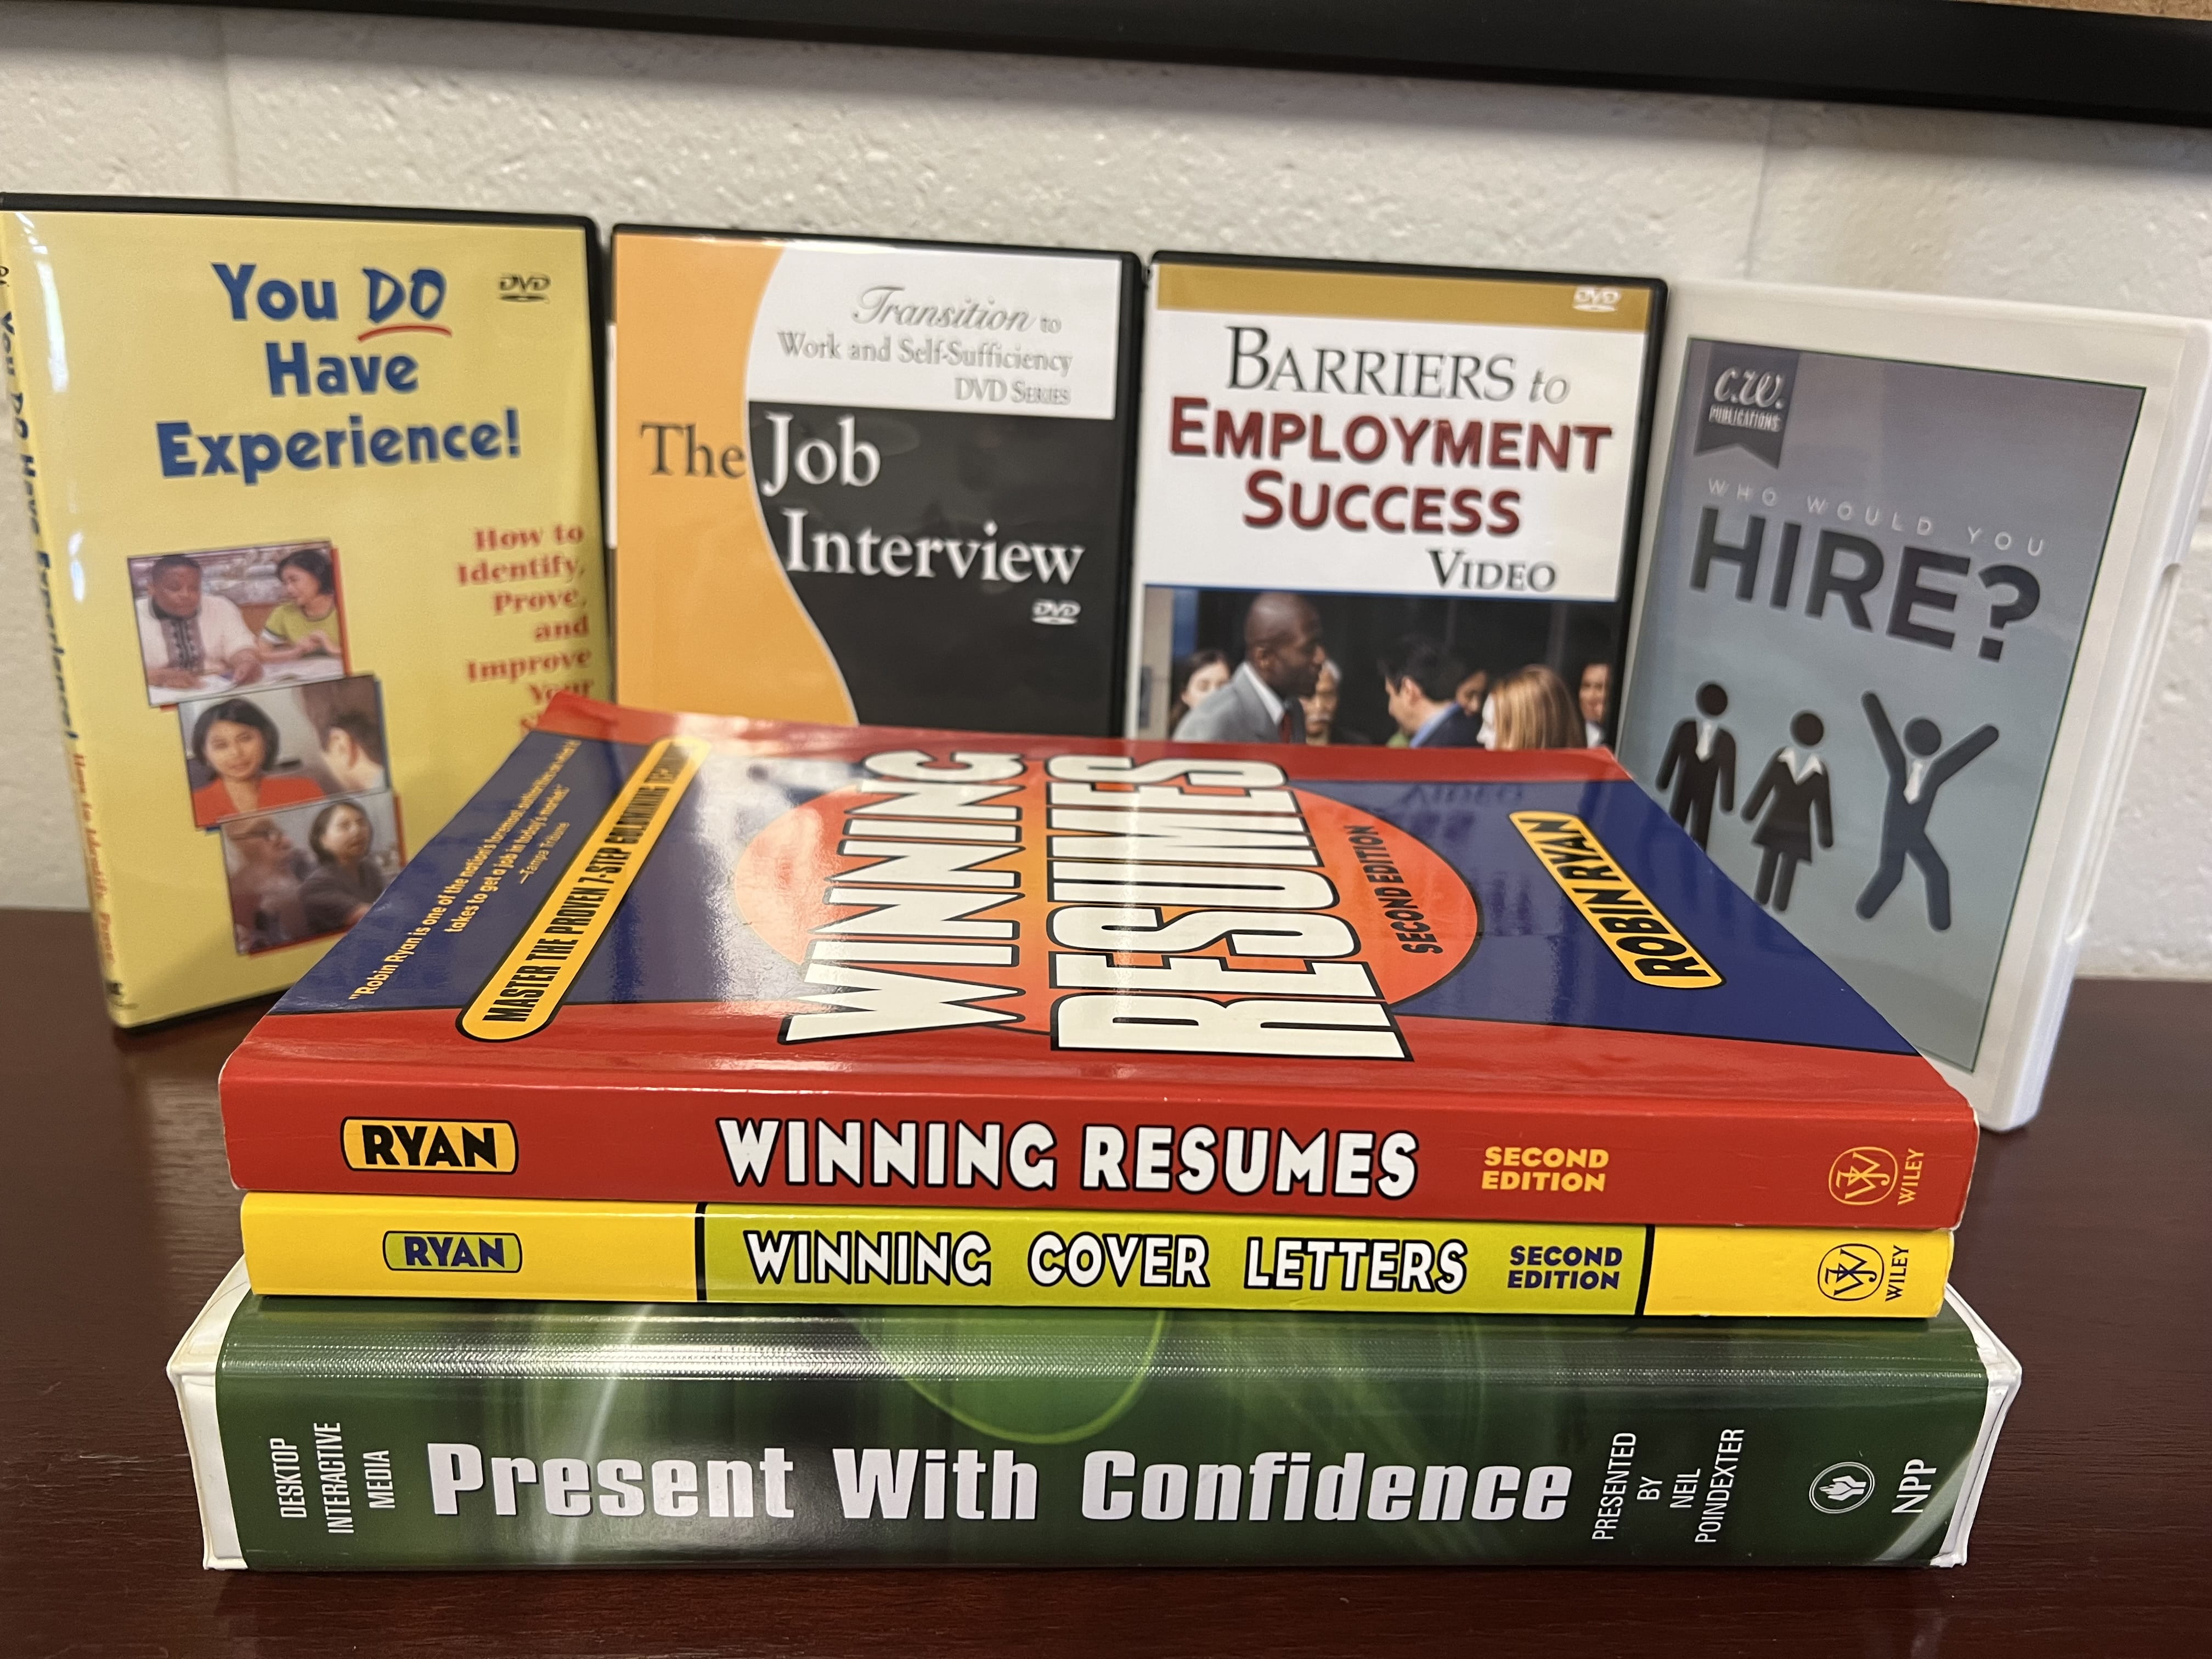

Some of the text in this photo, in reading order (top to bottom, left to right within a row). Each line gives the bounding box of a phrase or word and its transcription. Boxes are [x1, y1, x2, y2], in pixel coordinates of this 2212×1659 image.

[212, 262, 447, 324] You DO
[498, 273, 551, 296] DVD
[1573, 287, 1621, 308] DVD
[851, 285, 1061, 333] Transition to
[266, 341, 419, 398] Have
[777, 331, 1073, 373] Work and Self-Sufficiency
[1226, 325, 1571, 404] BARRIERS to
[955, 377, 1007, 403] DVD
[1169, 397, 1612, 473] EMPLOYMENT
[1708, 404, 1781, 432] PUBLICATIONS
[156, 407, 521, 486] Experience!
[641, 412, 881, 495] The Job
[1243, 470, 1521, 537] SUCCESS
[1708, 478, 2046, 557] WHO WOULD YOU
[475, 524, 584, 551] How to
[782, 509, 1085, 585] Interview
[458, 554, 584, 585] Identify,
[1425, 548, 1557, 593] VIDEO
[1689, 505, 2041, 664] HIRE?
[494, 589, 587, 614] Prove,
[1032, 600, 1081, 621] DVD
[535, 615, 589, 642] and
[468, 650, 592, 684] Improve
[493, 868, 507, 876] a
[494, 853, 518, 869] job
[438, 895, 456, 906] of
[444, 878, 469, 894] the
[466, 893, 488, 904] to
[479, 876, 501, 891] get
[778, 751, 1026, 1045] WINNING
[1344, 826, 1443, 953] SECOND EDITION
[1529, 819, 1712, 977] ROBIN RYAN
[422, 906, 447, 926] one
[444, 905, 480, 933] takes
[1043, 753, 1414, 1061] RESUMES
[384, 937, 422, 962] Ryan
[408, 927, 431, 936] is
[482, 847, 631, 1022] MASTER THE PROVEN 7-STEP
[362, 1125, 498, 1169] RYAN
[716, 1119, 1419, 1199] WINNING RESUMES
[1485, 1146, 1610, 1169] SECOND
[1481, 1171, 1606, 1193] EDITION
[1897, 1148, 1925, 1206] WILEY
[404, 1235, 506, 1268] RYAN
[743, 1229, 1469, 1293] WINNING COVER LETTERS
[1510, 1245, 1623, 1267] SECOND
[1885, 1244, 1909, 1302] WILEY
[1508, 1270, 1620, 1290] EDITION
[269, 1438, 307, 1519] DESKTOP
[313, 1423, 355, 1534] INTERACTIVE
[365, 1449, 397, 1509] MEDIA
[427, 1442, 1573, 1522] Present With Confidence
[1592, 1432, 1637, 1541] PRESENTED
[1637, 1476, 1663, 1501] BY
[1669, 1468, 1701, 1509] NEIL
[1695, 1429, 1745, 1543] POINDEXTER
[1892, 1458, 1937, 1514] NPP
